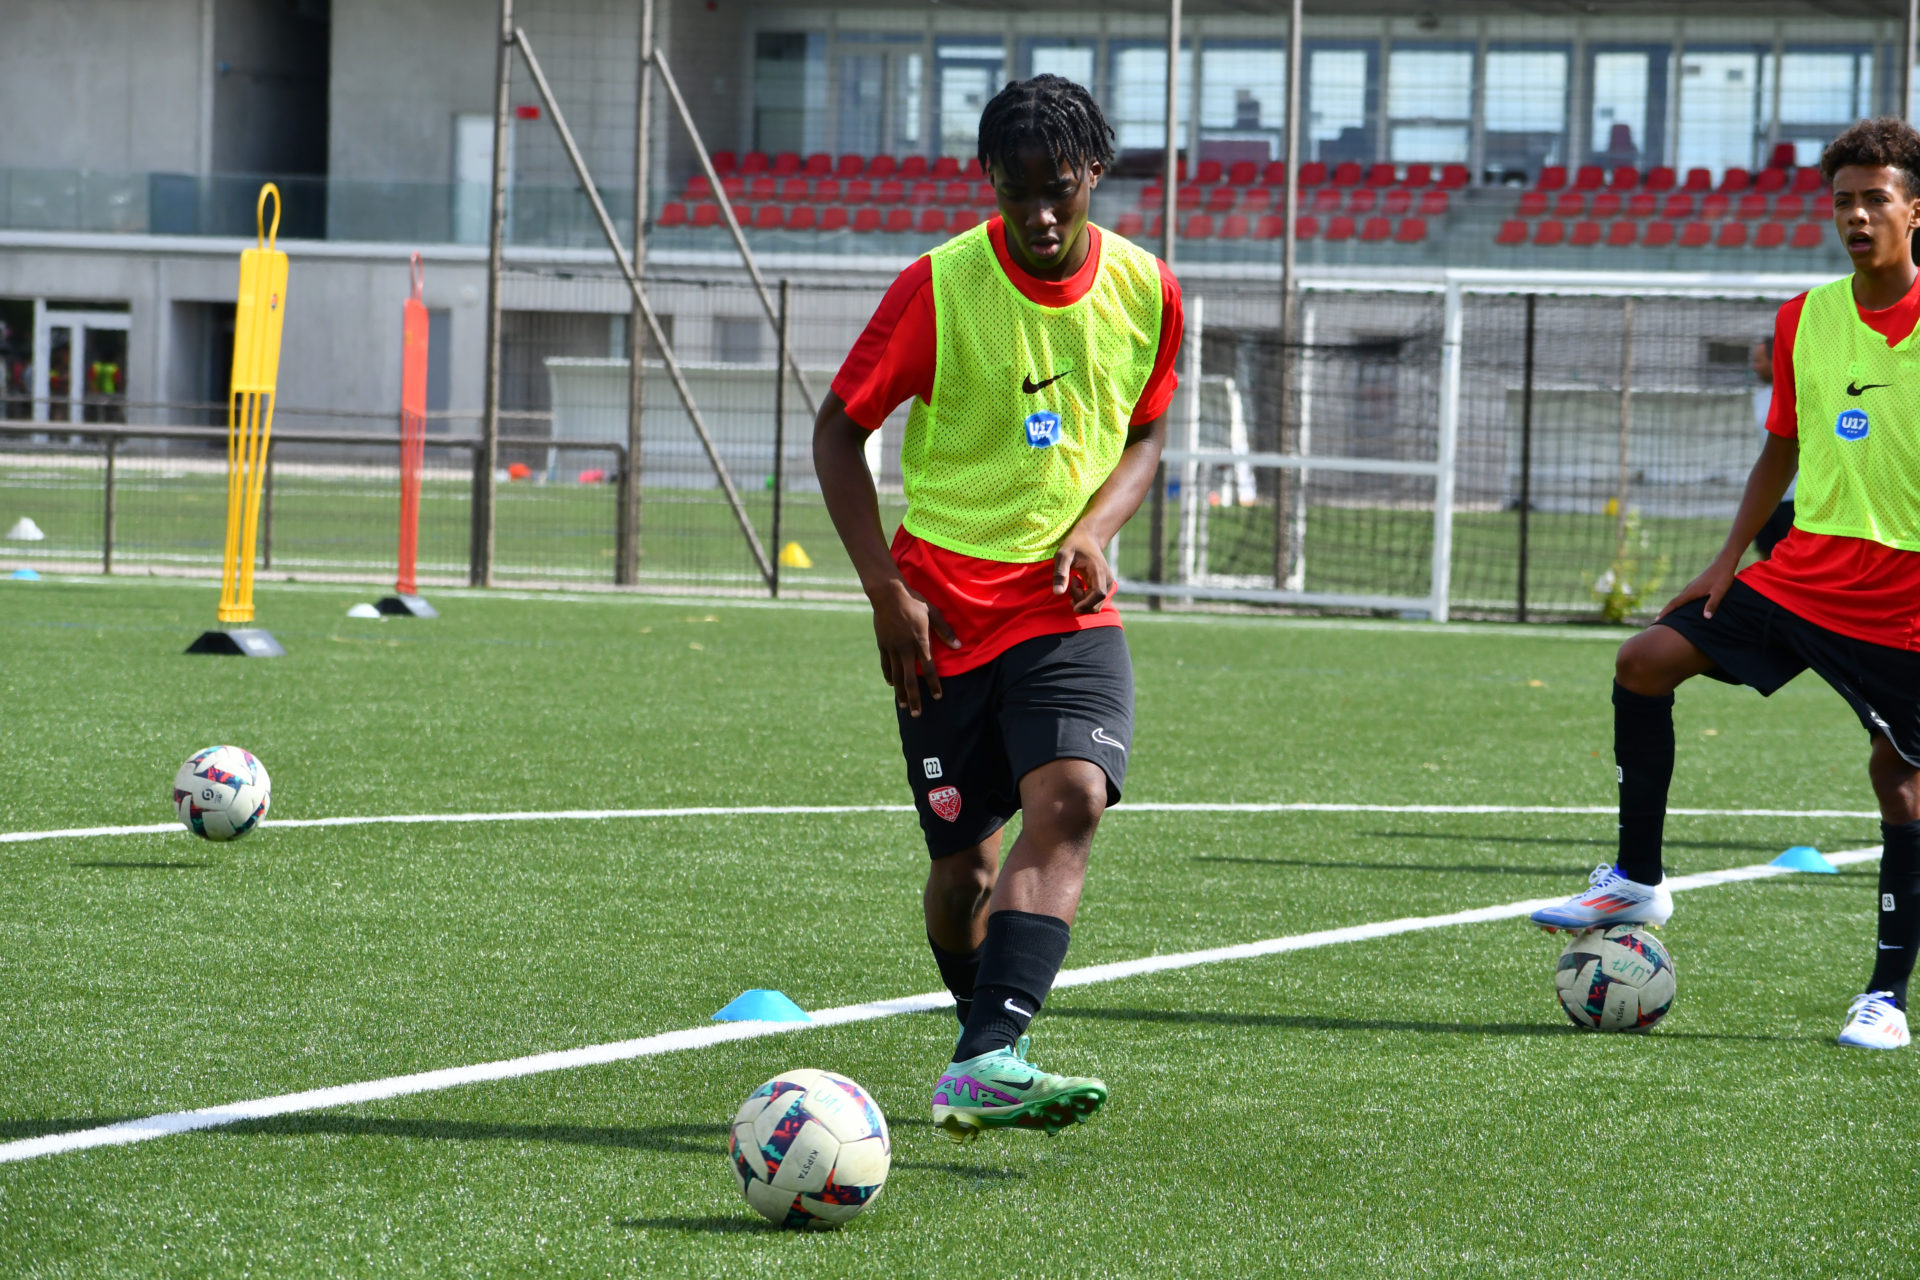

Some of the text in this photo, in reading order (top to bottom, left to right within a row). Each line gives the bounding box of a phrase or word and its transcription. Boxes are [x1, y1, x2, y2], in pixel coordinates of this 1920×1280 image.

[1029, 420, 1056, 436] U17
[1841, 416, 1867, 431] U17
[925, 761, 940, 776] C22
[929, 788, 958, 801] DFCO
[797, 1149, 819, 1179] KIPSTA
